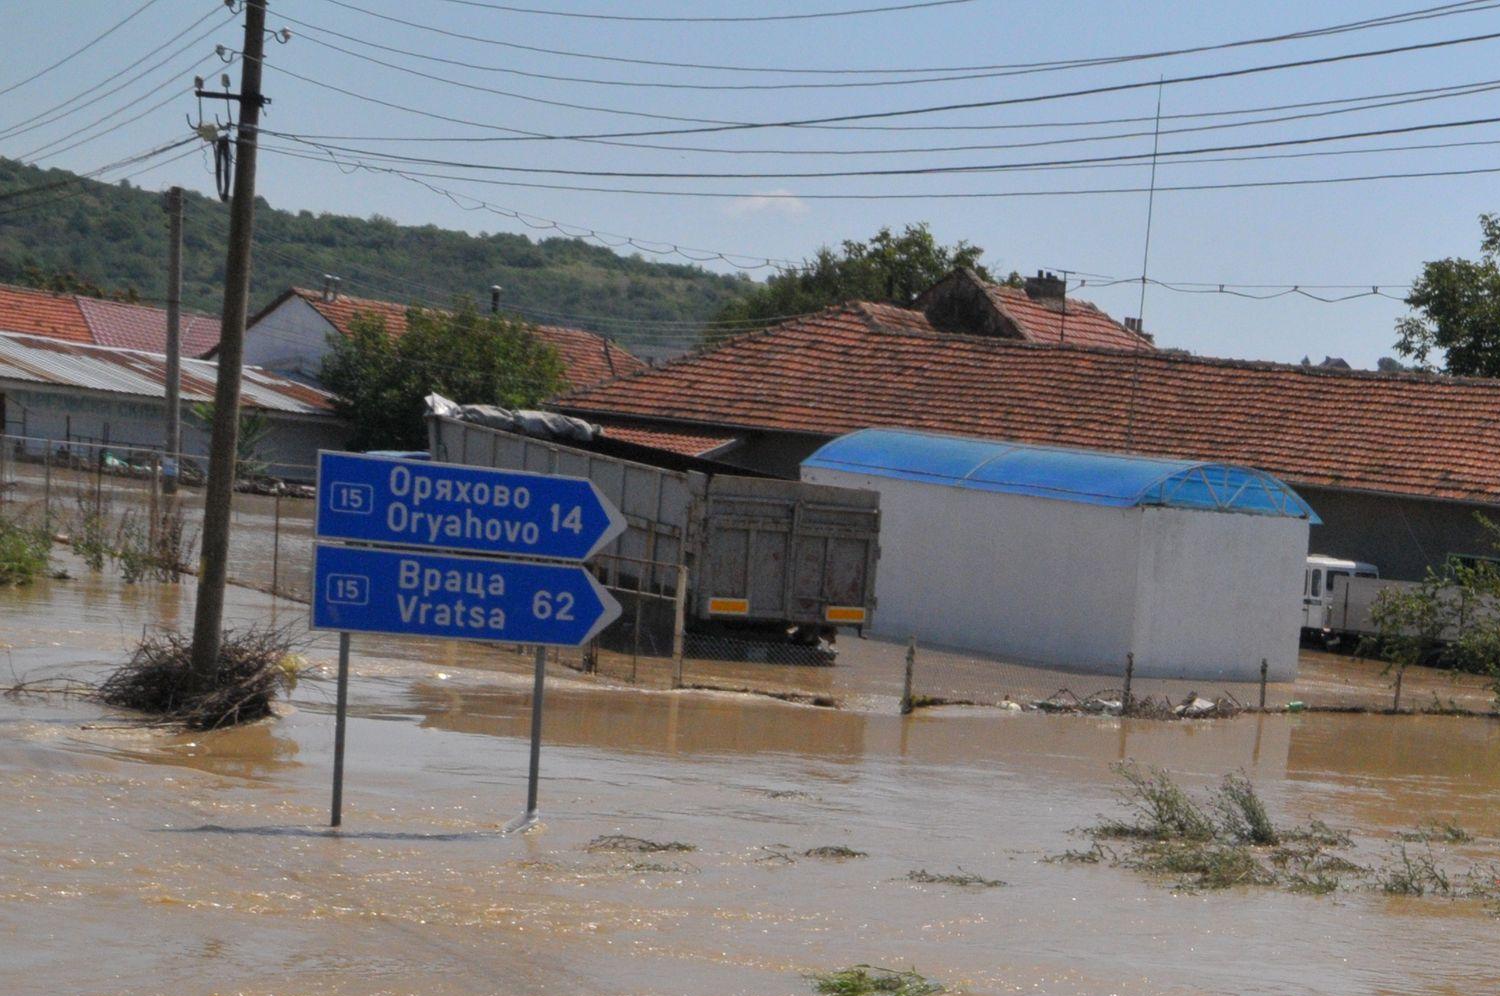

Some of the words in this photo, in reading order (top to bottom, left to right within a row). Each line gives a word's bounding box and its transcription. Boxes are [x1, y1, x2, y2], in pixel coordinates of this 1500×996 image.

[340, 488, 363, 508] 15
[390, 466, 530, 509] Оряхово
[387, 502, 539, 545] Oryahovo
[551, 503, 583, 535] 14
[336, 579, 359, 599] 15
[400, 560, 505, 599] Враца
[397, 594, 506, 630] Vratsa
[532, 590, 575, 621] 62
